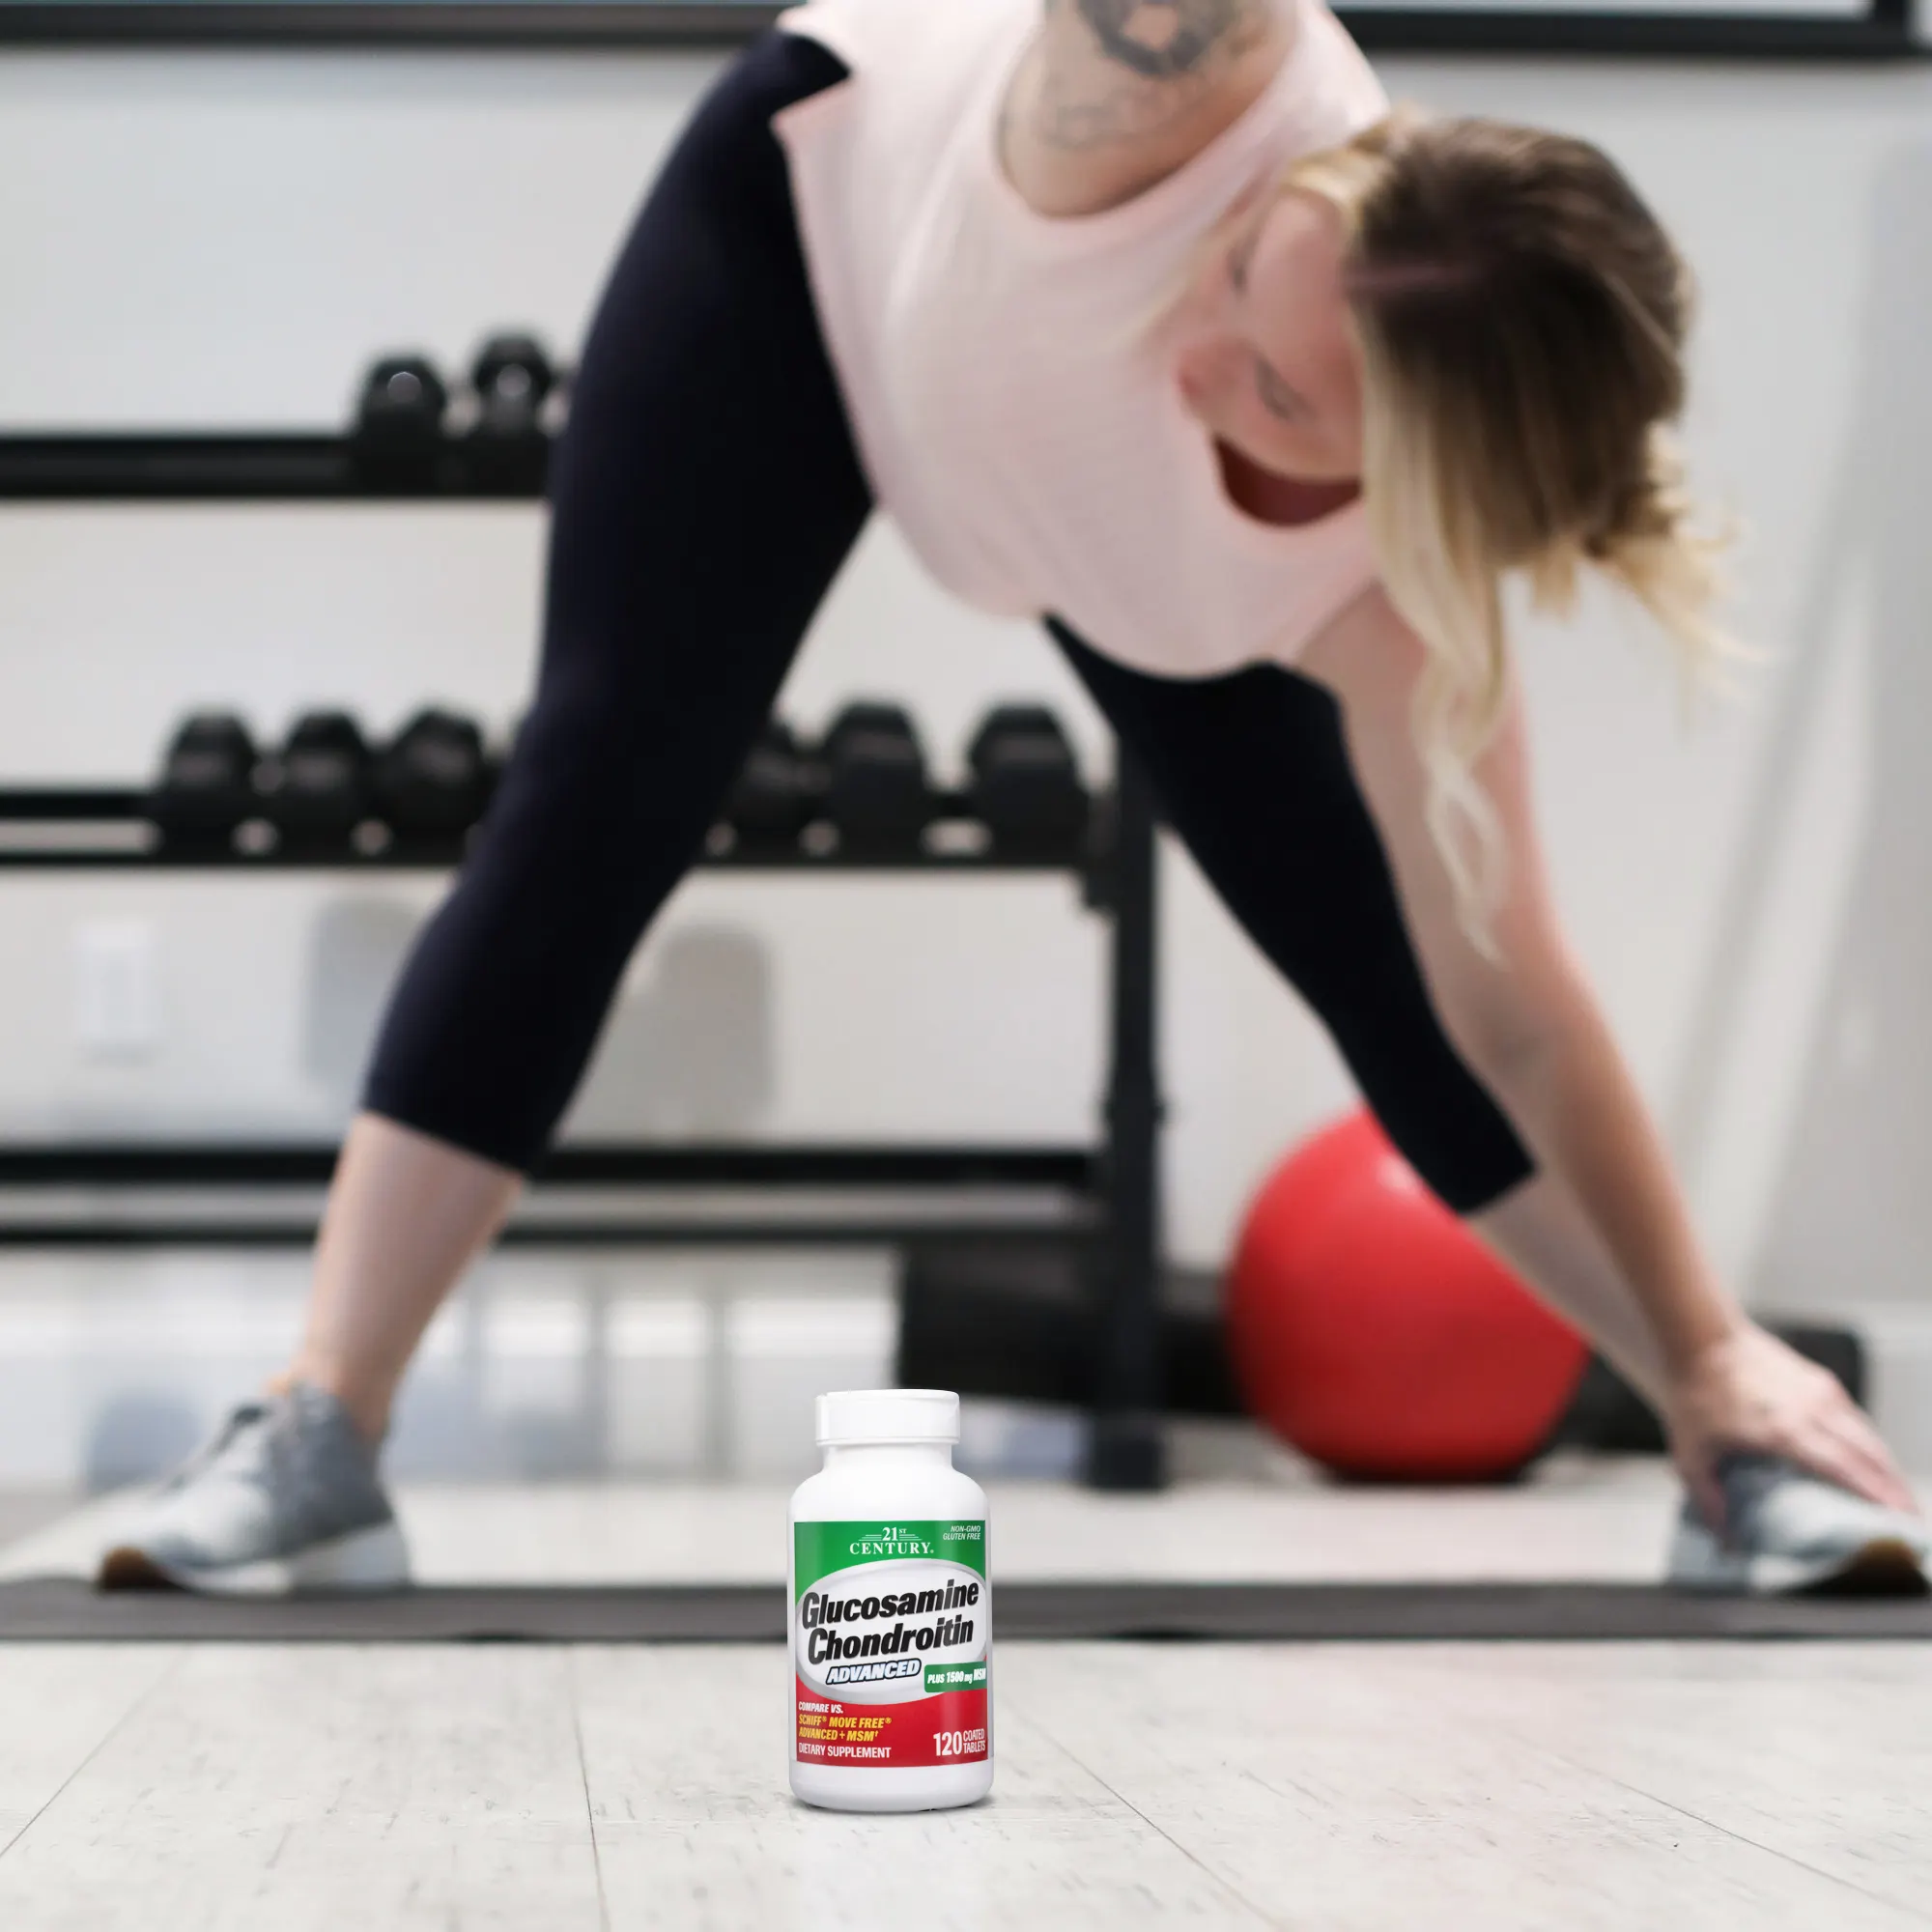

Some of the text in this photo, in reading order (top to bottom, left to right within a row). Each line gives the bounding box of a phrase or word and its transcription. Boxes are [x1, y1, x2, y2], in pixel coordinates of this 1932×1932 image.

[849, 1542, 931, 1555] CENTURY
[802, 1578, 980, 1630] Glucosamine
[808, 1614, 975, 1665] Chondroitin
[825, 1658, 922, 1685] ADVANCED
[927, 1672, 945, 1684] PLUS
[946, 1671, 964, 1684] 1500
[798, 1701, 844, 1714] COMPARE VS.
[829, 1716, 857, 1728] MOVE
[798, 1726, 838, 1741] ADVANCED
[963, 1728, 985, 1741] COATED
[798, 1742, 892, 1758] DIETARY SUPPLEMENT
[933, 1731, 963, 1756] 120
[963, 1740, 986, 1754] TABLETS
